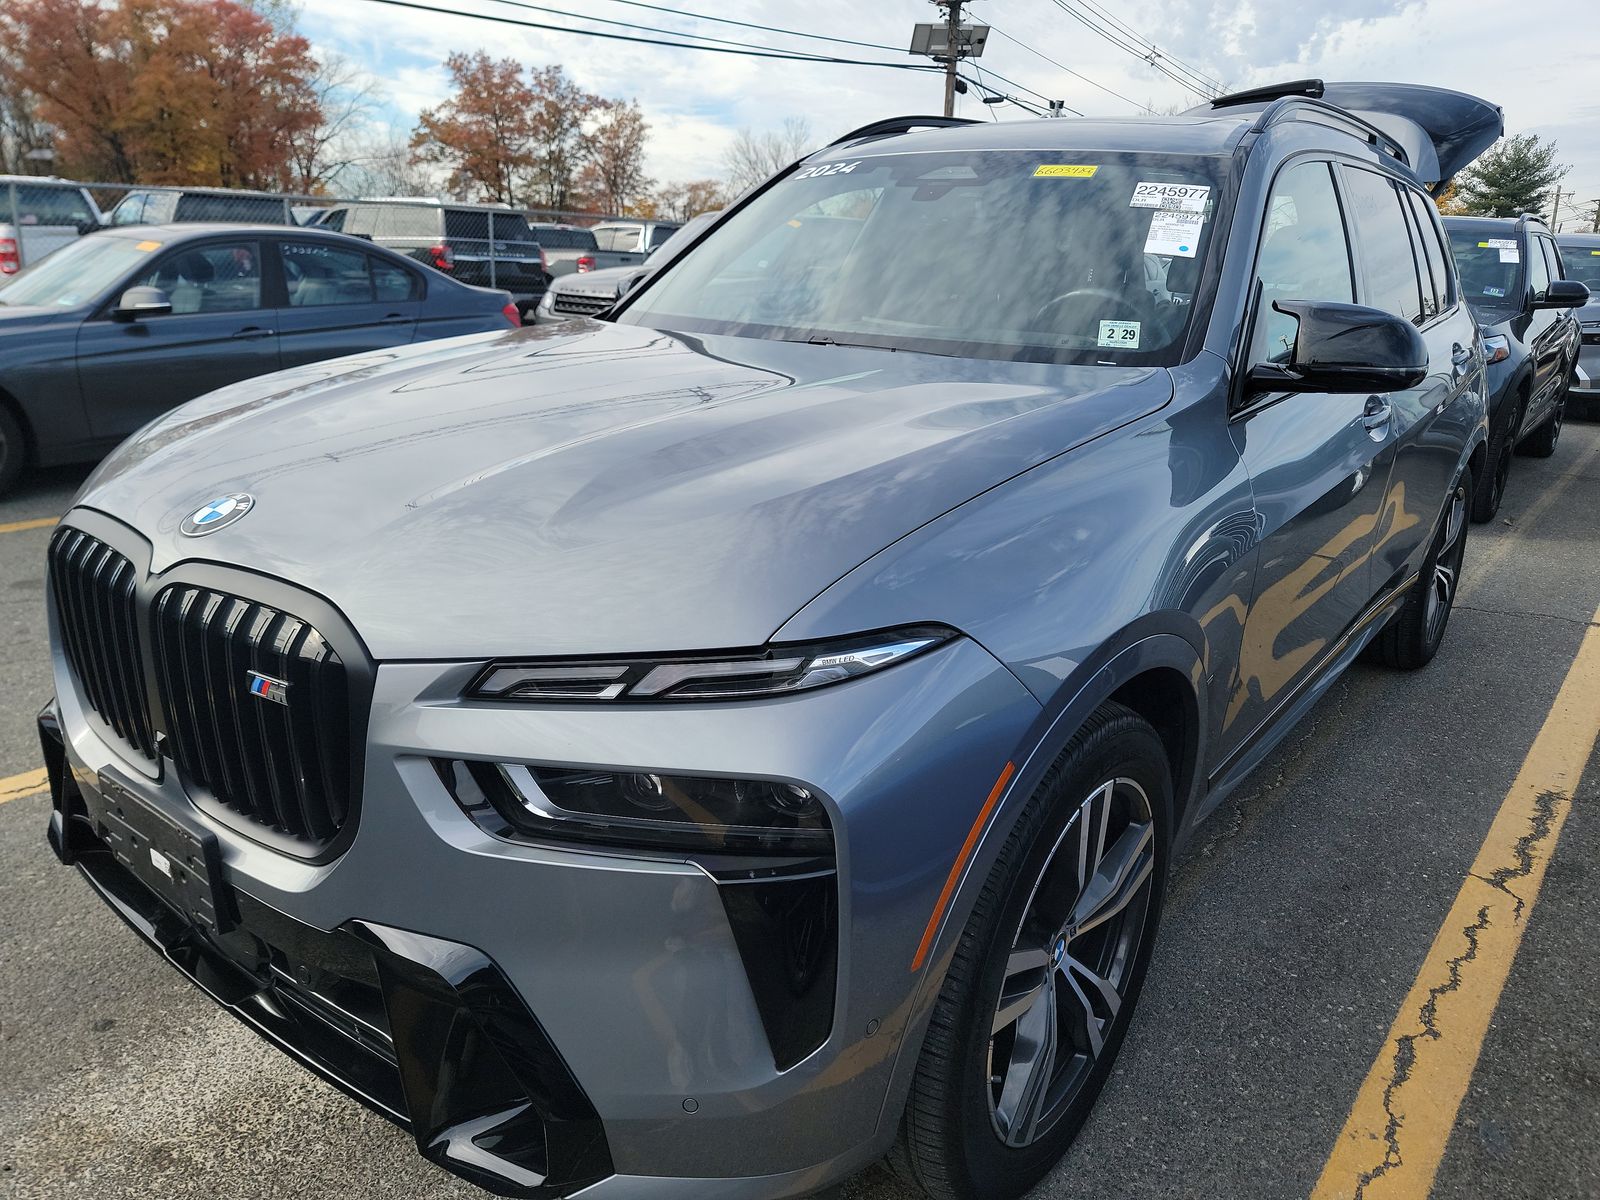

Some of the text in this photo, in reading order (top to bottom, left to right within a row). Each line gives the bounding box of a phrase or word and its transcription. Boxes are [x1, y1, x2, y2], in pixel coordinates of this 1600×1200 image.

[794, 161, 863, 180] 2024
[1136, 185, 1209, 199] 2245977
[1154, 212, 1203, 221] 2245977
[1106, 328, 1136, 340] 2 29
